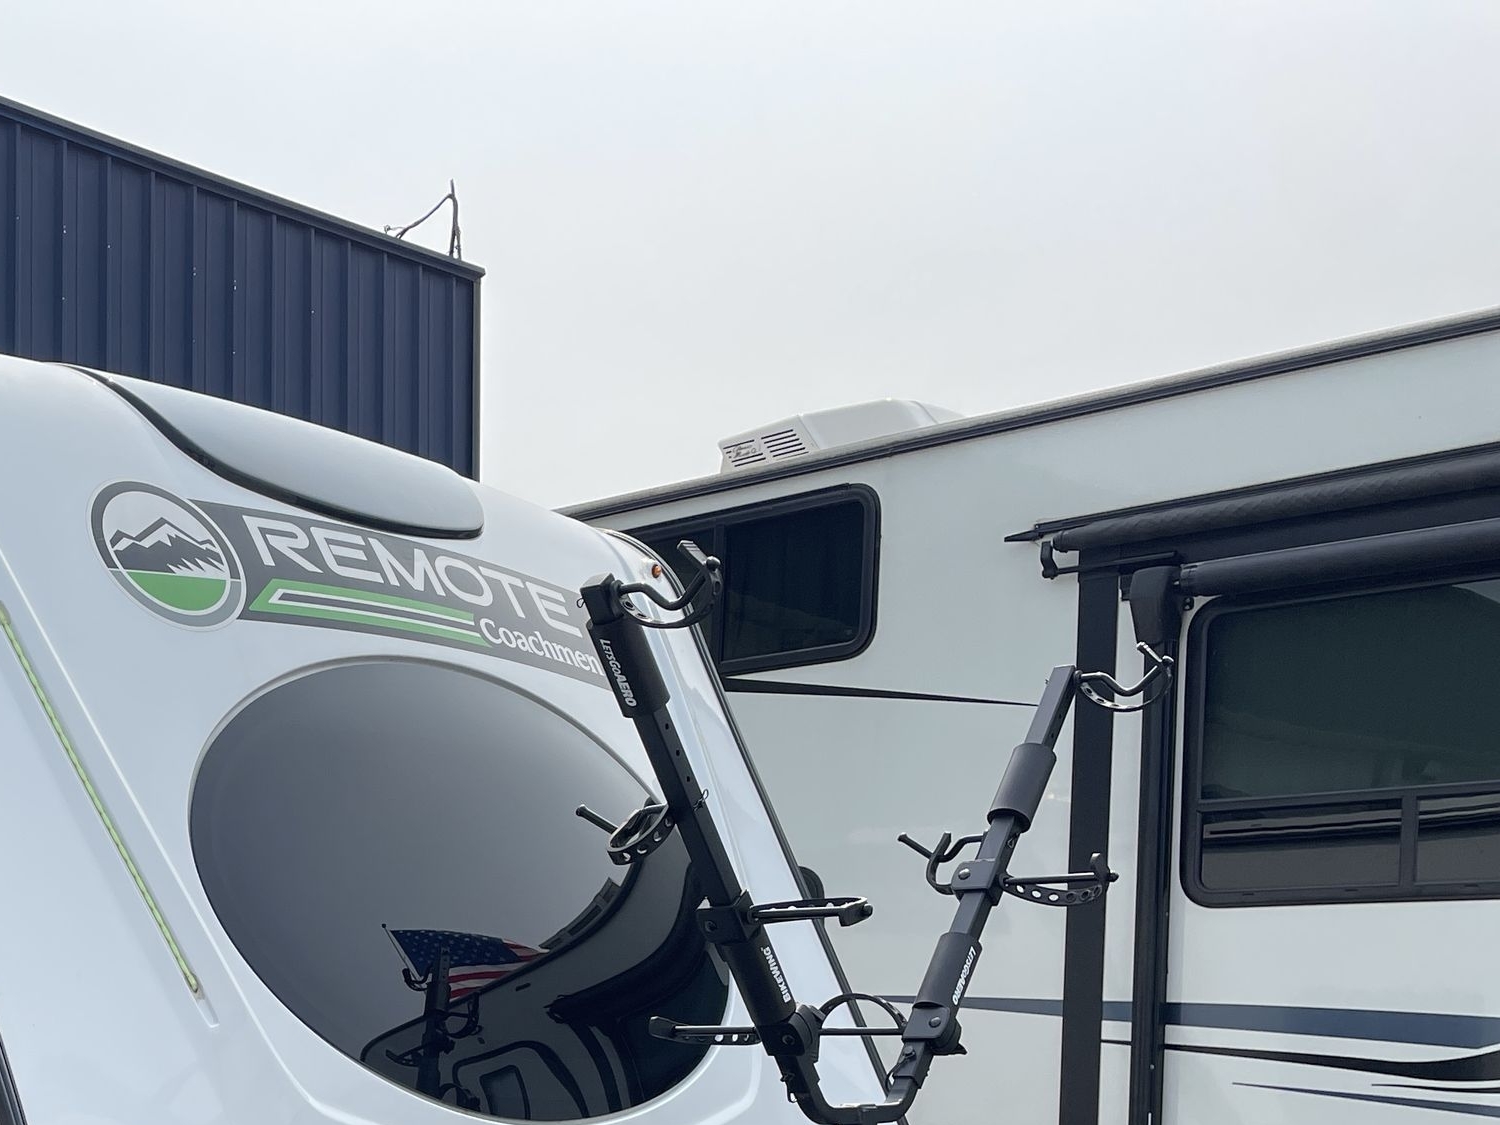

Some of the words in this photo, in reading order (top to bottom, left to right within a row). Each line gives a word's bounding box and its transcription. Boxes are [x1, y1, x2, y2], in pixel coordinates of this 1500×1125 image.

[242, 515, 583, 638] REMOTE
[479, 617, 605, 676] Coachmen
[763, 946, 791, 1003] BIKEWING
